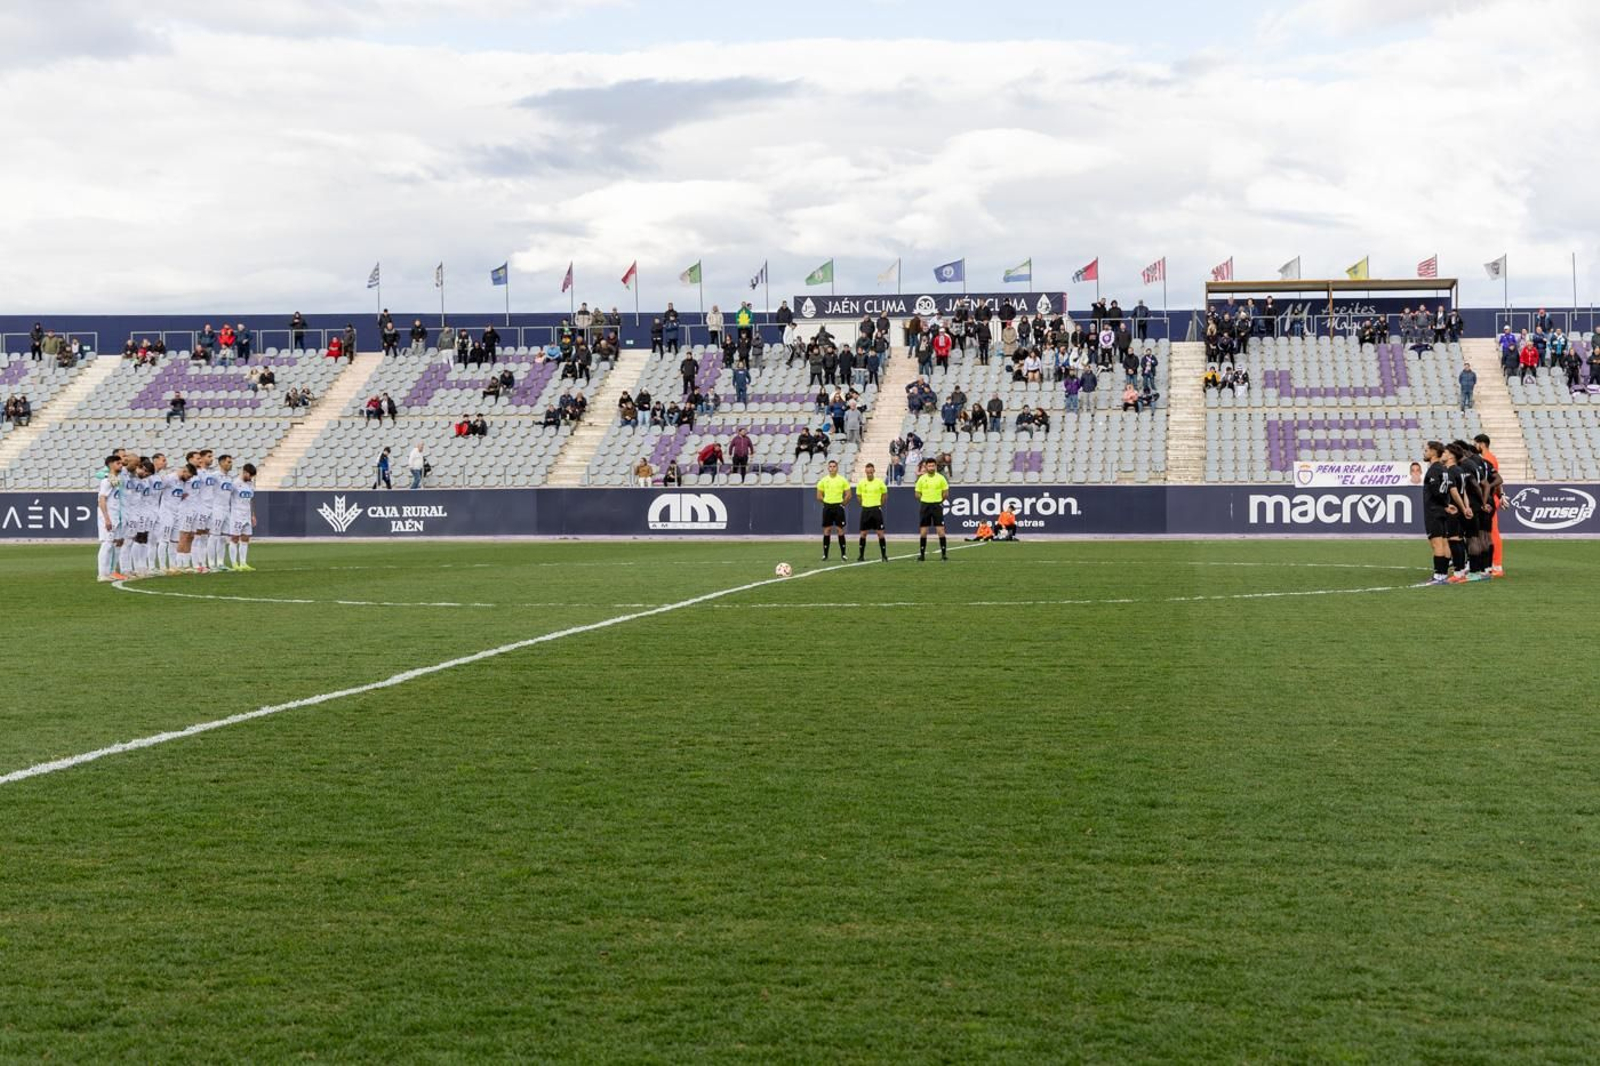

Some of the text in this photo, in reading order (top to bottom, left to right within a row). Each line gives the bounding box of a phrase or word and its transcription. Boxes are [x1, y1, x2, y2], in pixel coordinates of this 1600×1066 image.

[825, 297, 859, 314] JAÉN
[864, 299, 907, 313] CLIMA
[1343, 465, 1366, 473] REAL
[367, 506, 447, 518] CAJA RURAL
[1249, 494, 1412, 523] macron
[1531, 503, 1594, 522] proseja
[391, 519, 424, 532] JAÉN
